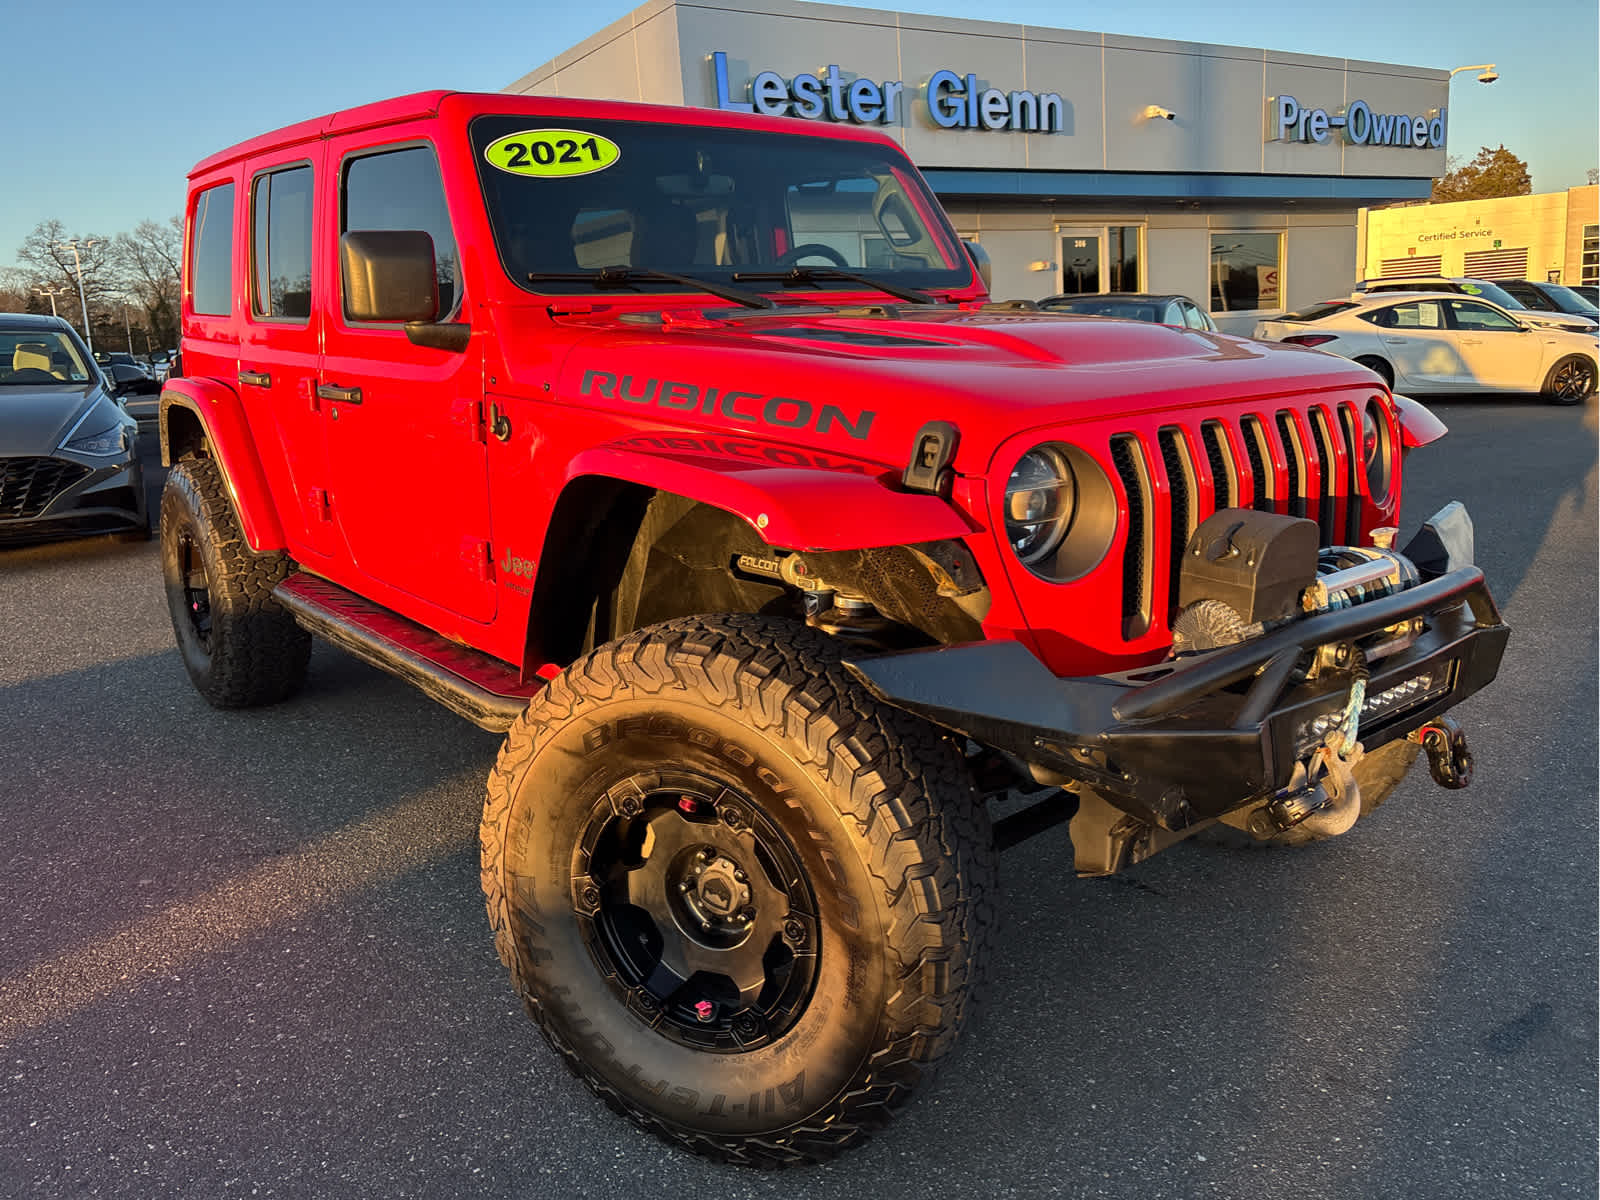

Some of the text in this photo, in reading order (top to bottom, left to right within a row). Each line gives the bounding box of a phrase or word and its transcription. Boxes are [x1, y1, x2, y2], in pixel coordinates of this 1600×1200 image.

[712, 51, 1064, 133] Lester Glenn
[1278, 94, 1446, 147] Pre-Owned
[503, 138, 601, 168] 2021
[1417, 228, 1493, 243] Certified Service
[579, 369, 877, 441] RUBICON
[739, 555, 779, 573] FALCON
